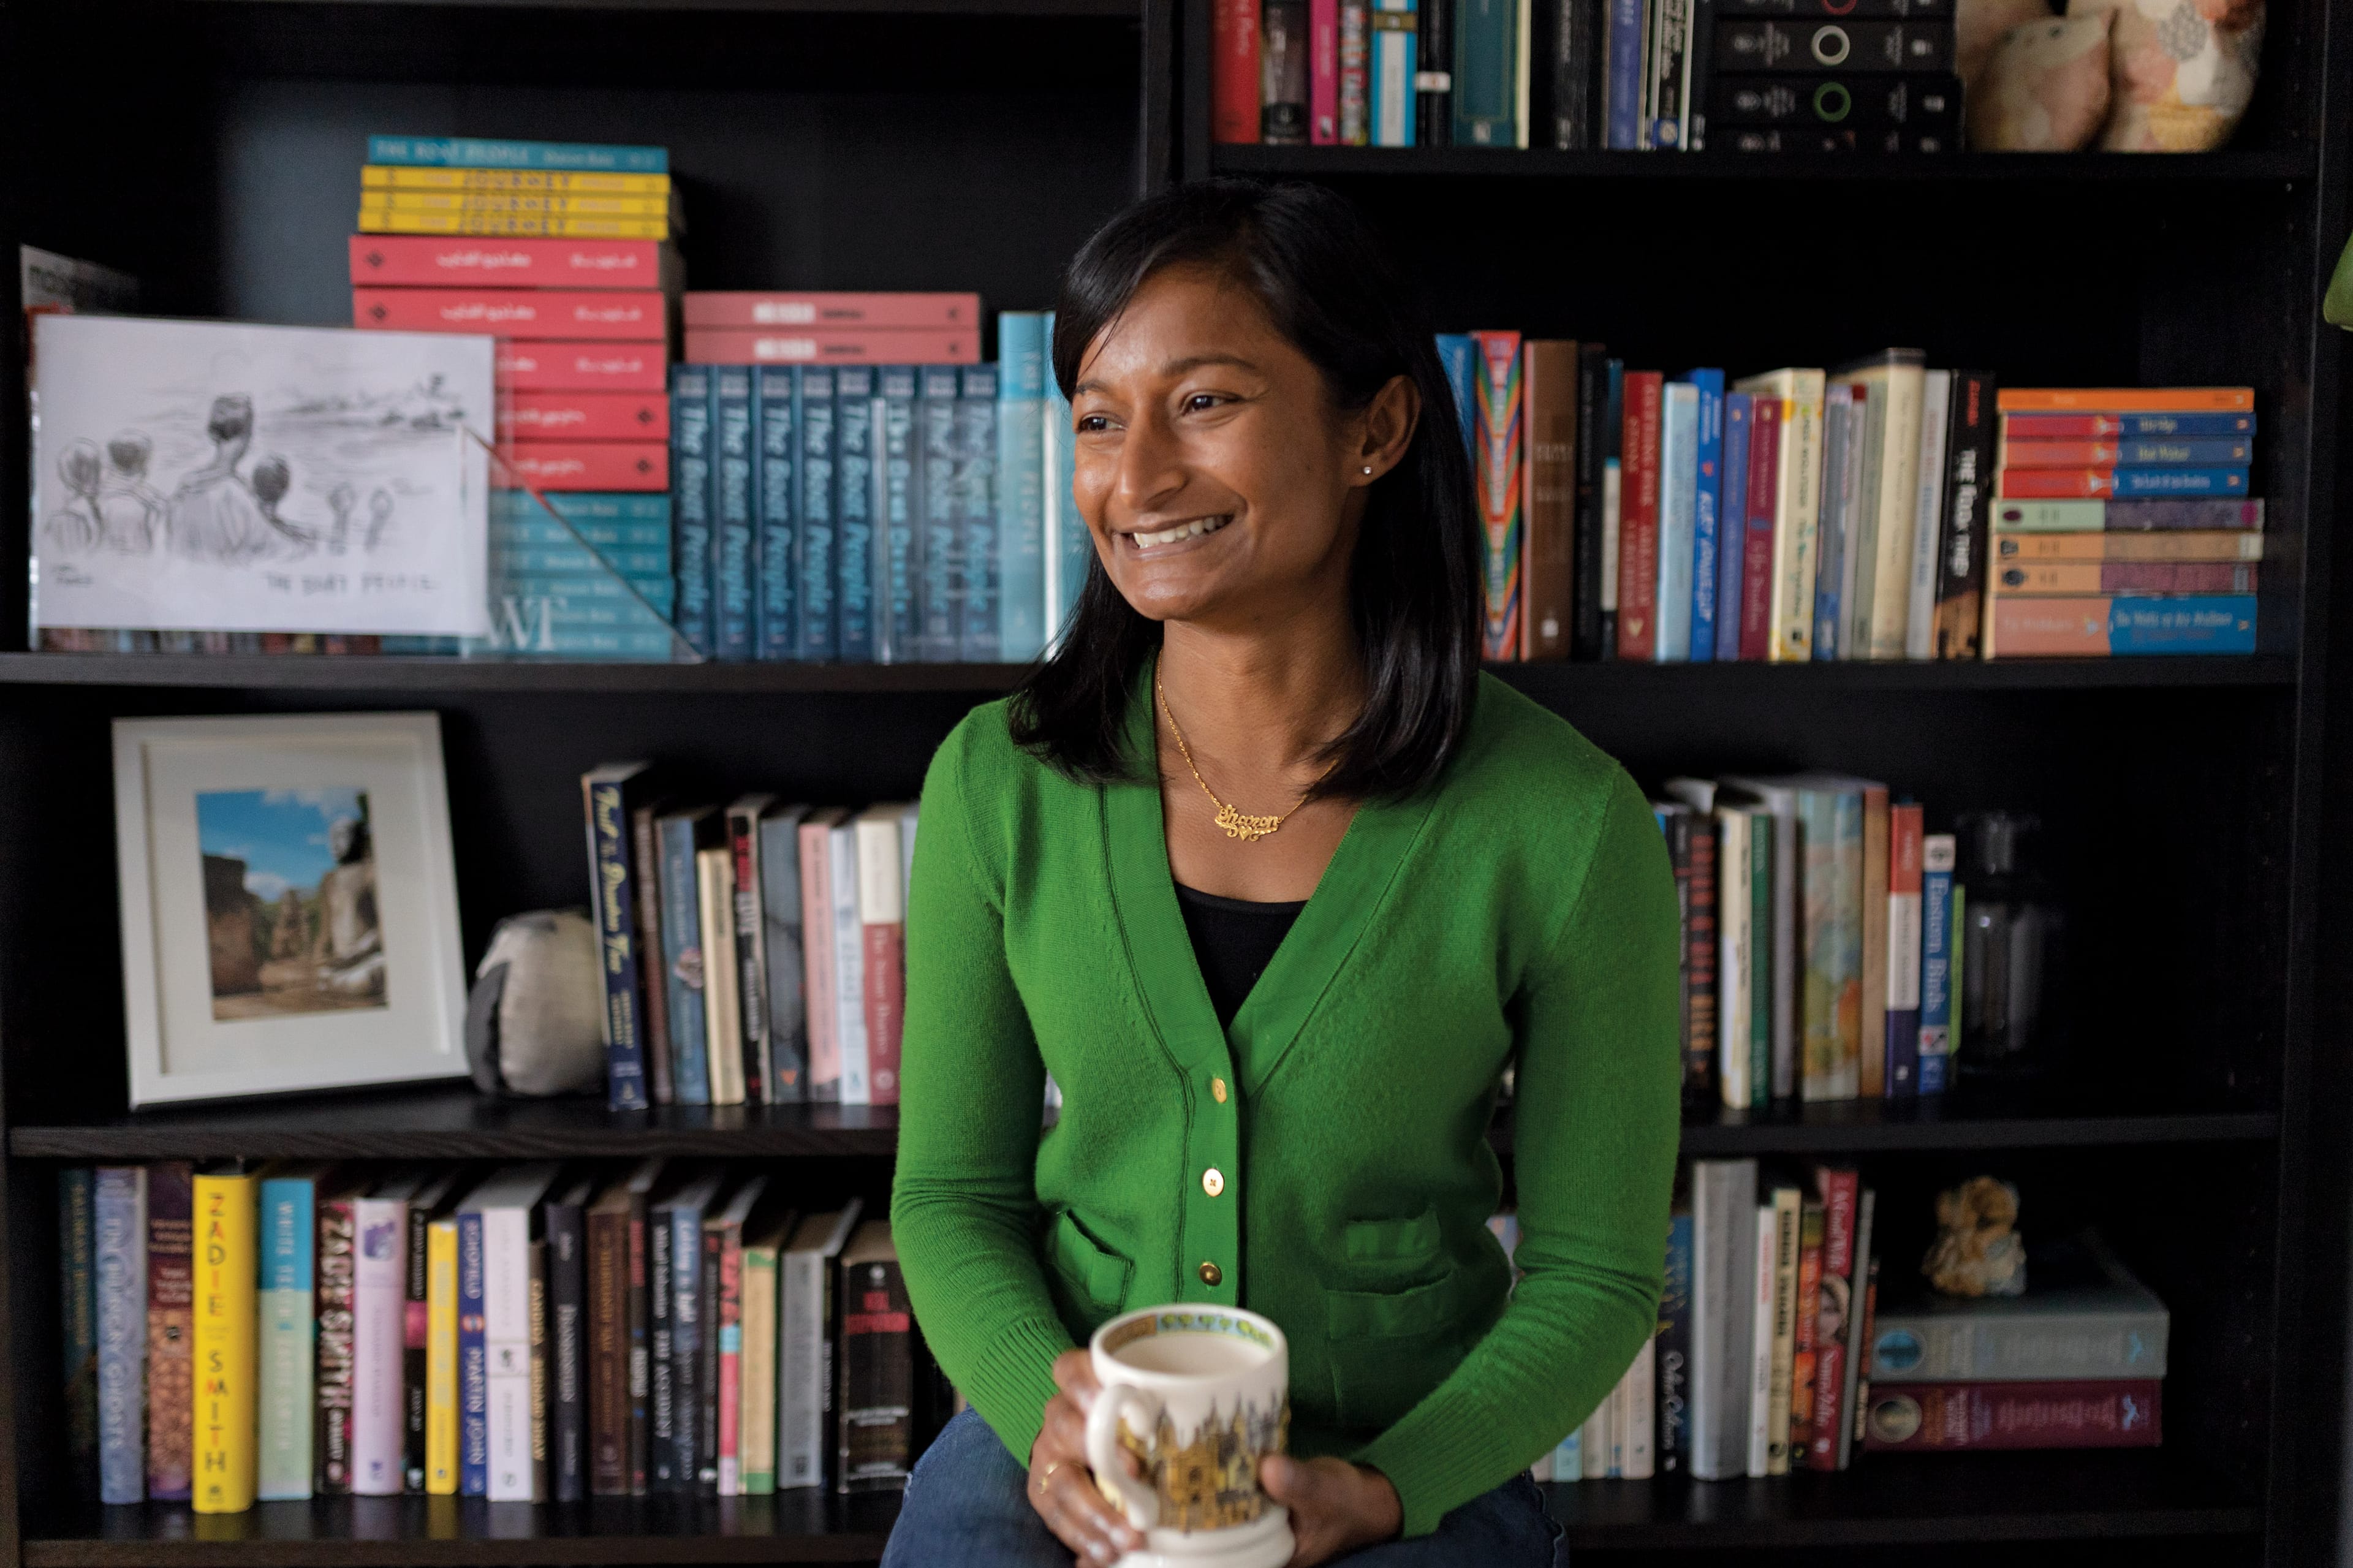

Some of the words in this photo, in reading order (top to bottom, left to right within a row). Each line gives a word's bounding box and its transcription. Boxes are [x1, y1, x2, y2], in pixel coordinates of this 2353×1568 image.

[681, 405, 707, 453] The
[723, 405, 748, 453] The
[765, 405, 790, 453] The
[806, 405, 832, 453] The
[844, 402, 869, 450] The
[680, 458, 708, 520] Boat
[721, 458, 749, 520] Boat
[764, 458, 791, 520] Boat
[804, 458, 832, 520] Boat
[843, 455, 870, 517] Boat
[1957, 450, 1976, 483] THE
[679, 526, 709, 613] People
[721, 526, 750, 613] People
[763, 526, 793, 613] People
[803, 526, 833, 613] People
[841, 523, 871, 613] People
[1928, 877, 1949, 953] Eastern
[1926, 957, 1948, 1013] Birds
[207, 1192, 226, 1317] ZADIE
[319, 1216, 353, 1305] ZADIE
[319, 1308, 353, 1408] SMITH
[556, 1303, 577, 1403] FRANKENSTEIN
[653, 1329, 672, 1360] THE
[205, 1349, 228, 1472] SMITH
[467, 1347, 485, 1412] MARTIN
[654, 1363, 673, 1440] ACCIDENT
[467, 1415, 485, 1465] JOHN
[532, 1420, 545, 1461] SHAW
